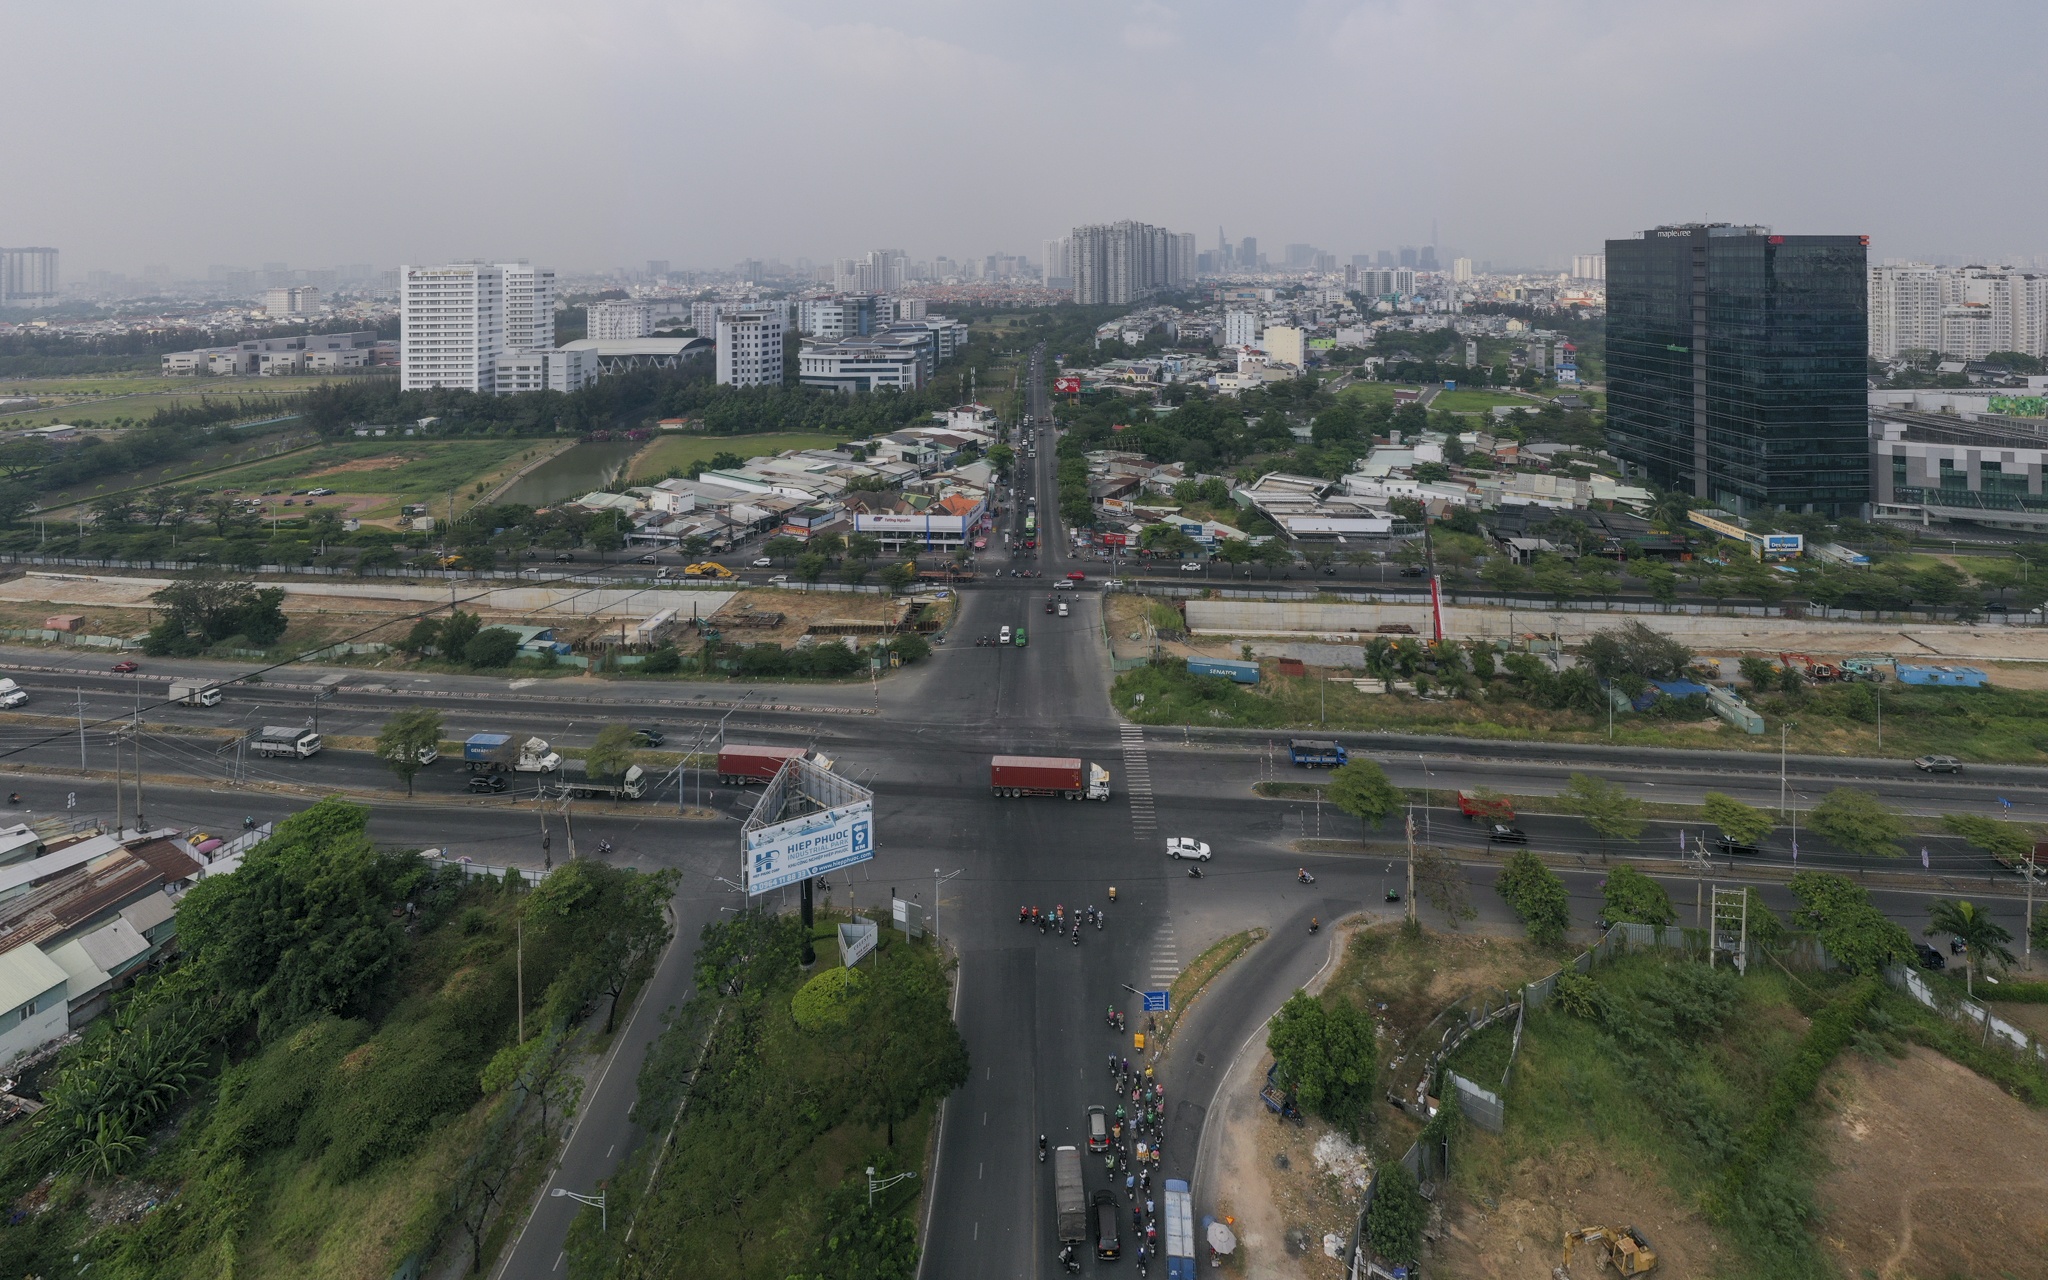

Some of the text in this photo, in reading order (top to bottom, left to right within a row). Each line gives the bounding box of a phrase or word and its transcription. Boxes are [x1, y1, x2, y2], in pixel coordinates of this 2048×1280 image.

[1657, 229, 1691, 239] mapletree
[1209, 668, 1237, 676] SENATOR
[787, 829, 849, 854] HIEP PHUOC
[855, 831, 865, 844] 9
[787, 838, 849, 861] INDUSTRIAL PARK
[855, 843, 866, 851] KM
[818, 852, 872, 871] www.hiepphuoc.com
[779, 876, 786, 884] 11
[787, 873, 796, 881] 88
[797, 870, 806, 878] 33
